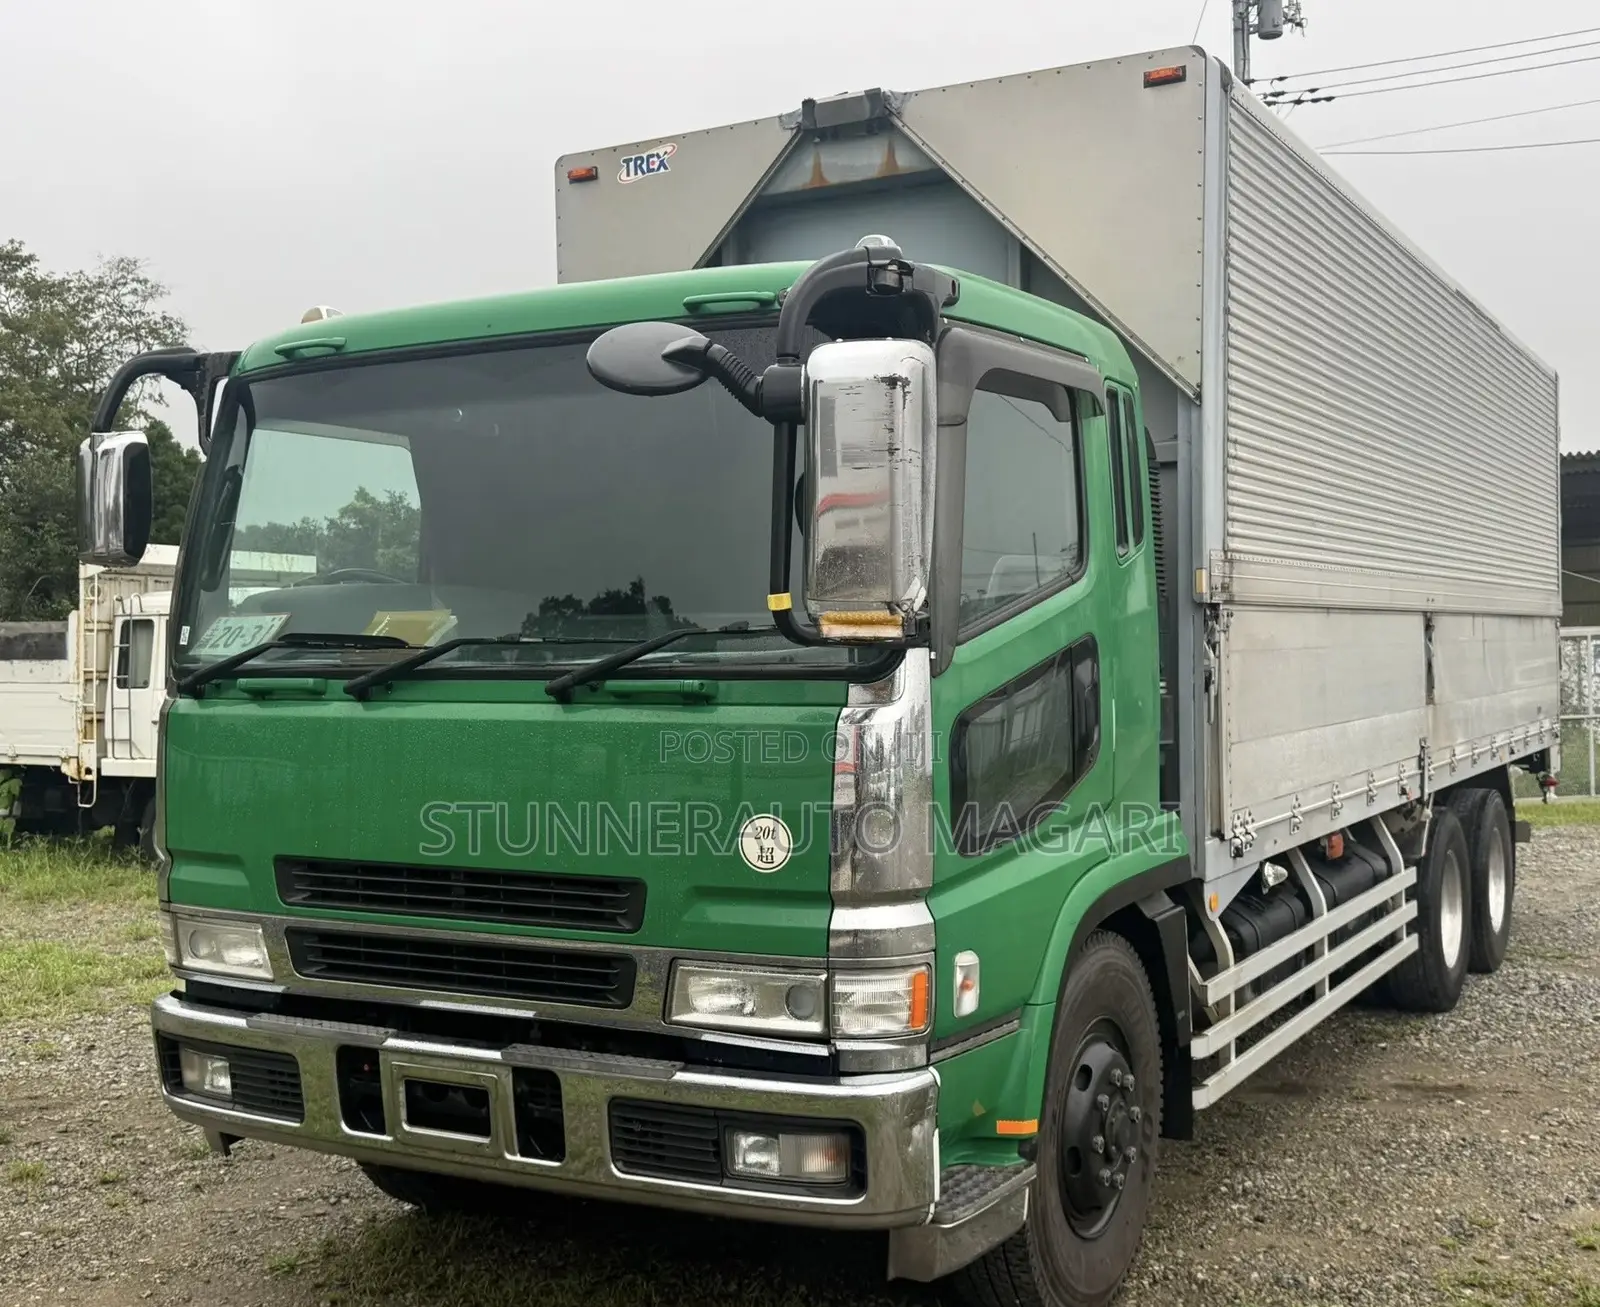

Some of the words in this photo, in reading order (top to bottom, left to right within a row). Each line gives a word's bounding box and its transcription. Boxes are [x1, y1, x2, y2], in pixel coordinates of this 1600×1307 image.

[622, 151, 669, 177] TREX
[754, 825, 777, 840] 20t
[757, 845, 775, 864] 超
